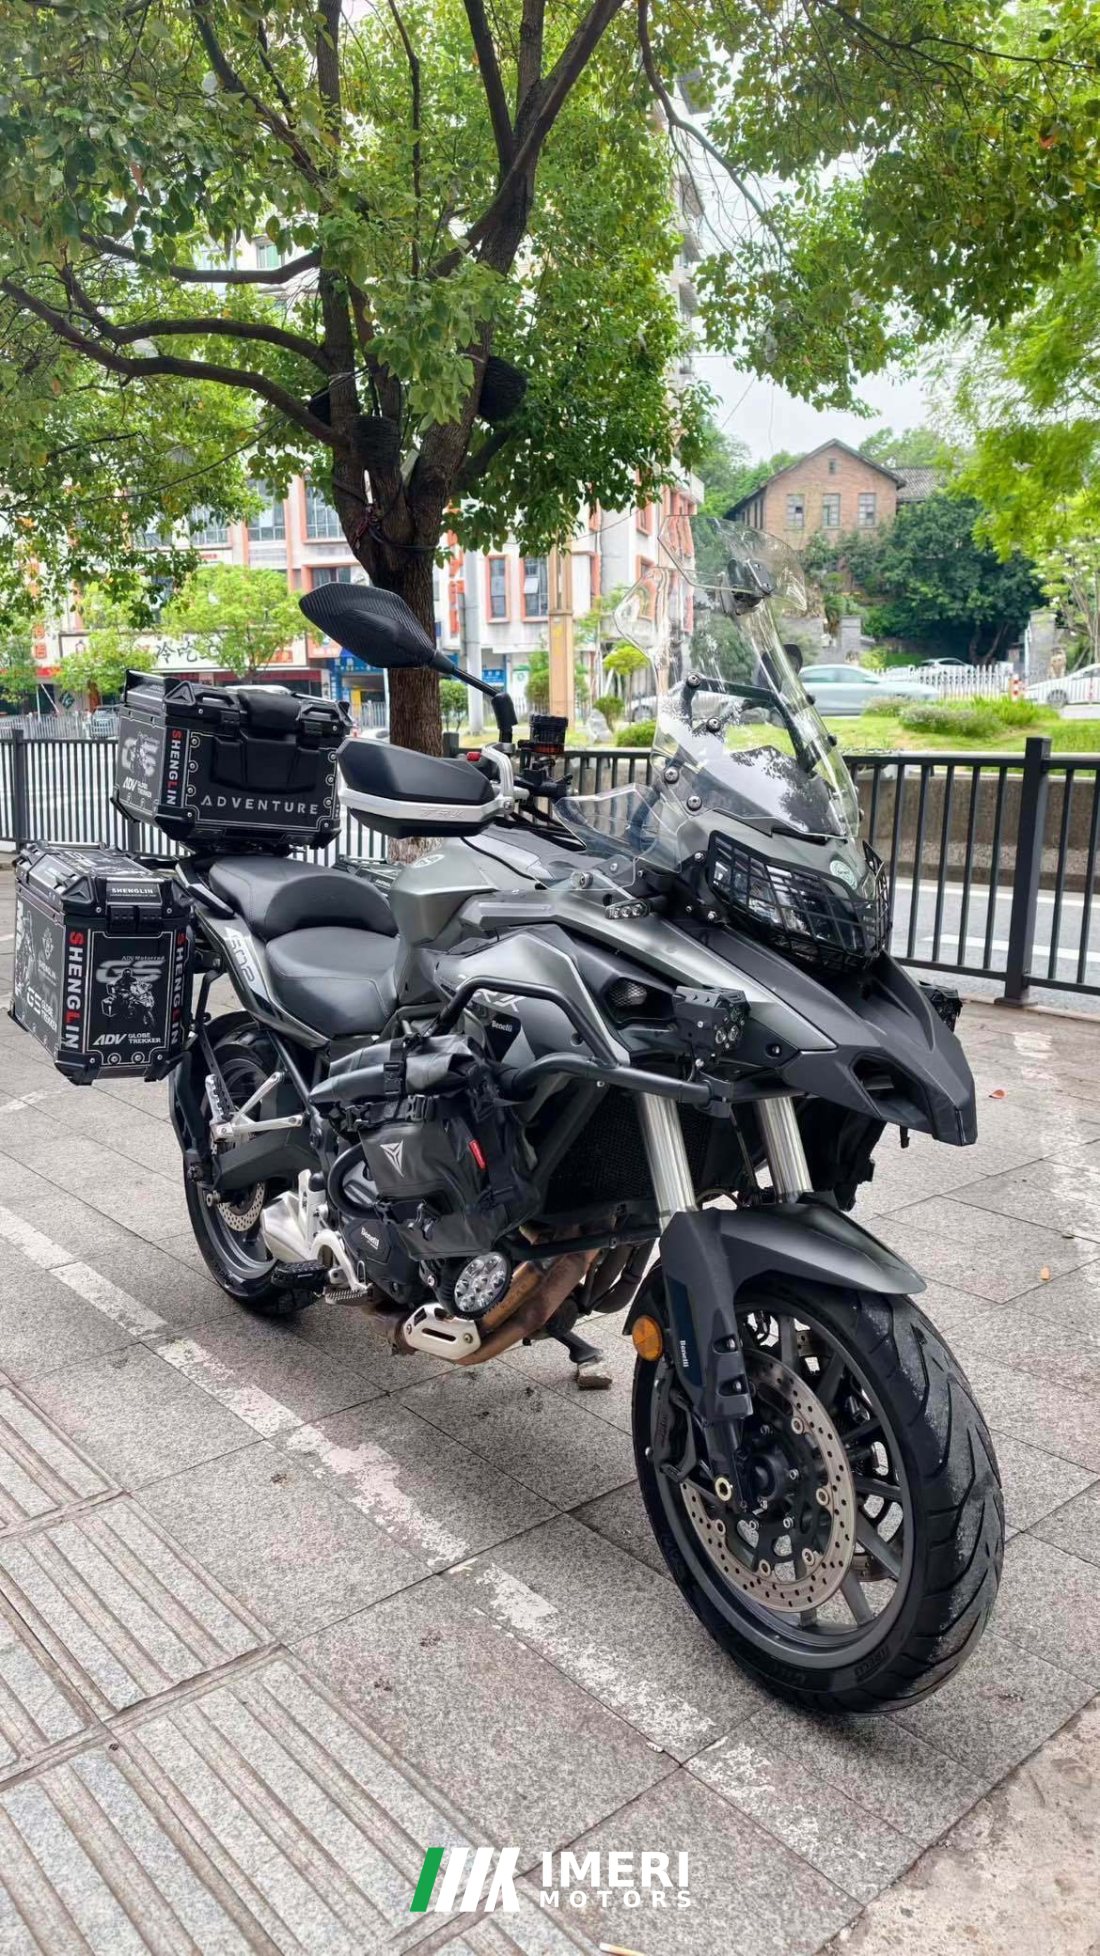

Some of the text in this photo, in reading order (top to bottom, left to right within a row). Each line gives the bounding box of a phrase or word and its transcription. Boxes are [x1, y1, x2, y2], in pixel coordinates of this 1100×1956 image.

[167, 729, 183, 806] SHENGLIN
[200, 795, 319, 816] ADVENTURE
[96, 960, 166, 984] GS
[65, 931, 84, 1049] SHENGLIN
[171, 932, 187, 1046] SHENGLIN
[491, 1020, 513, 1033] Benelli
[92, 1034, 127, 1046] ADV
[680, 1340, 690, 1368] Benelli
